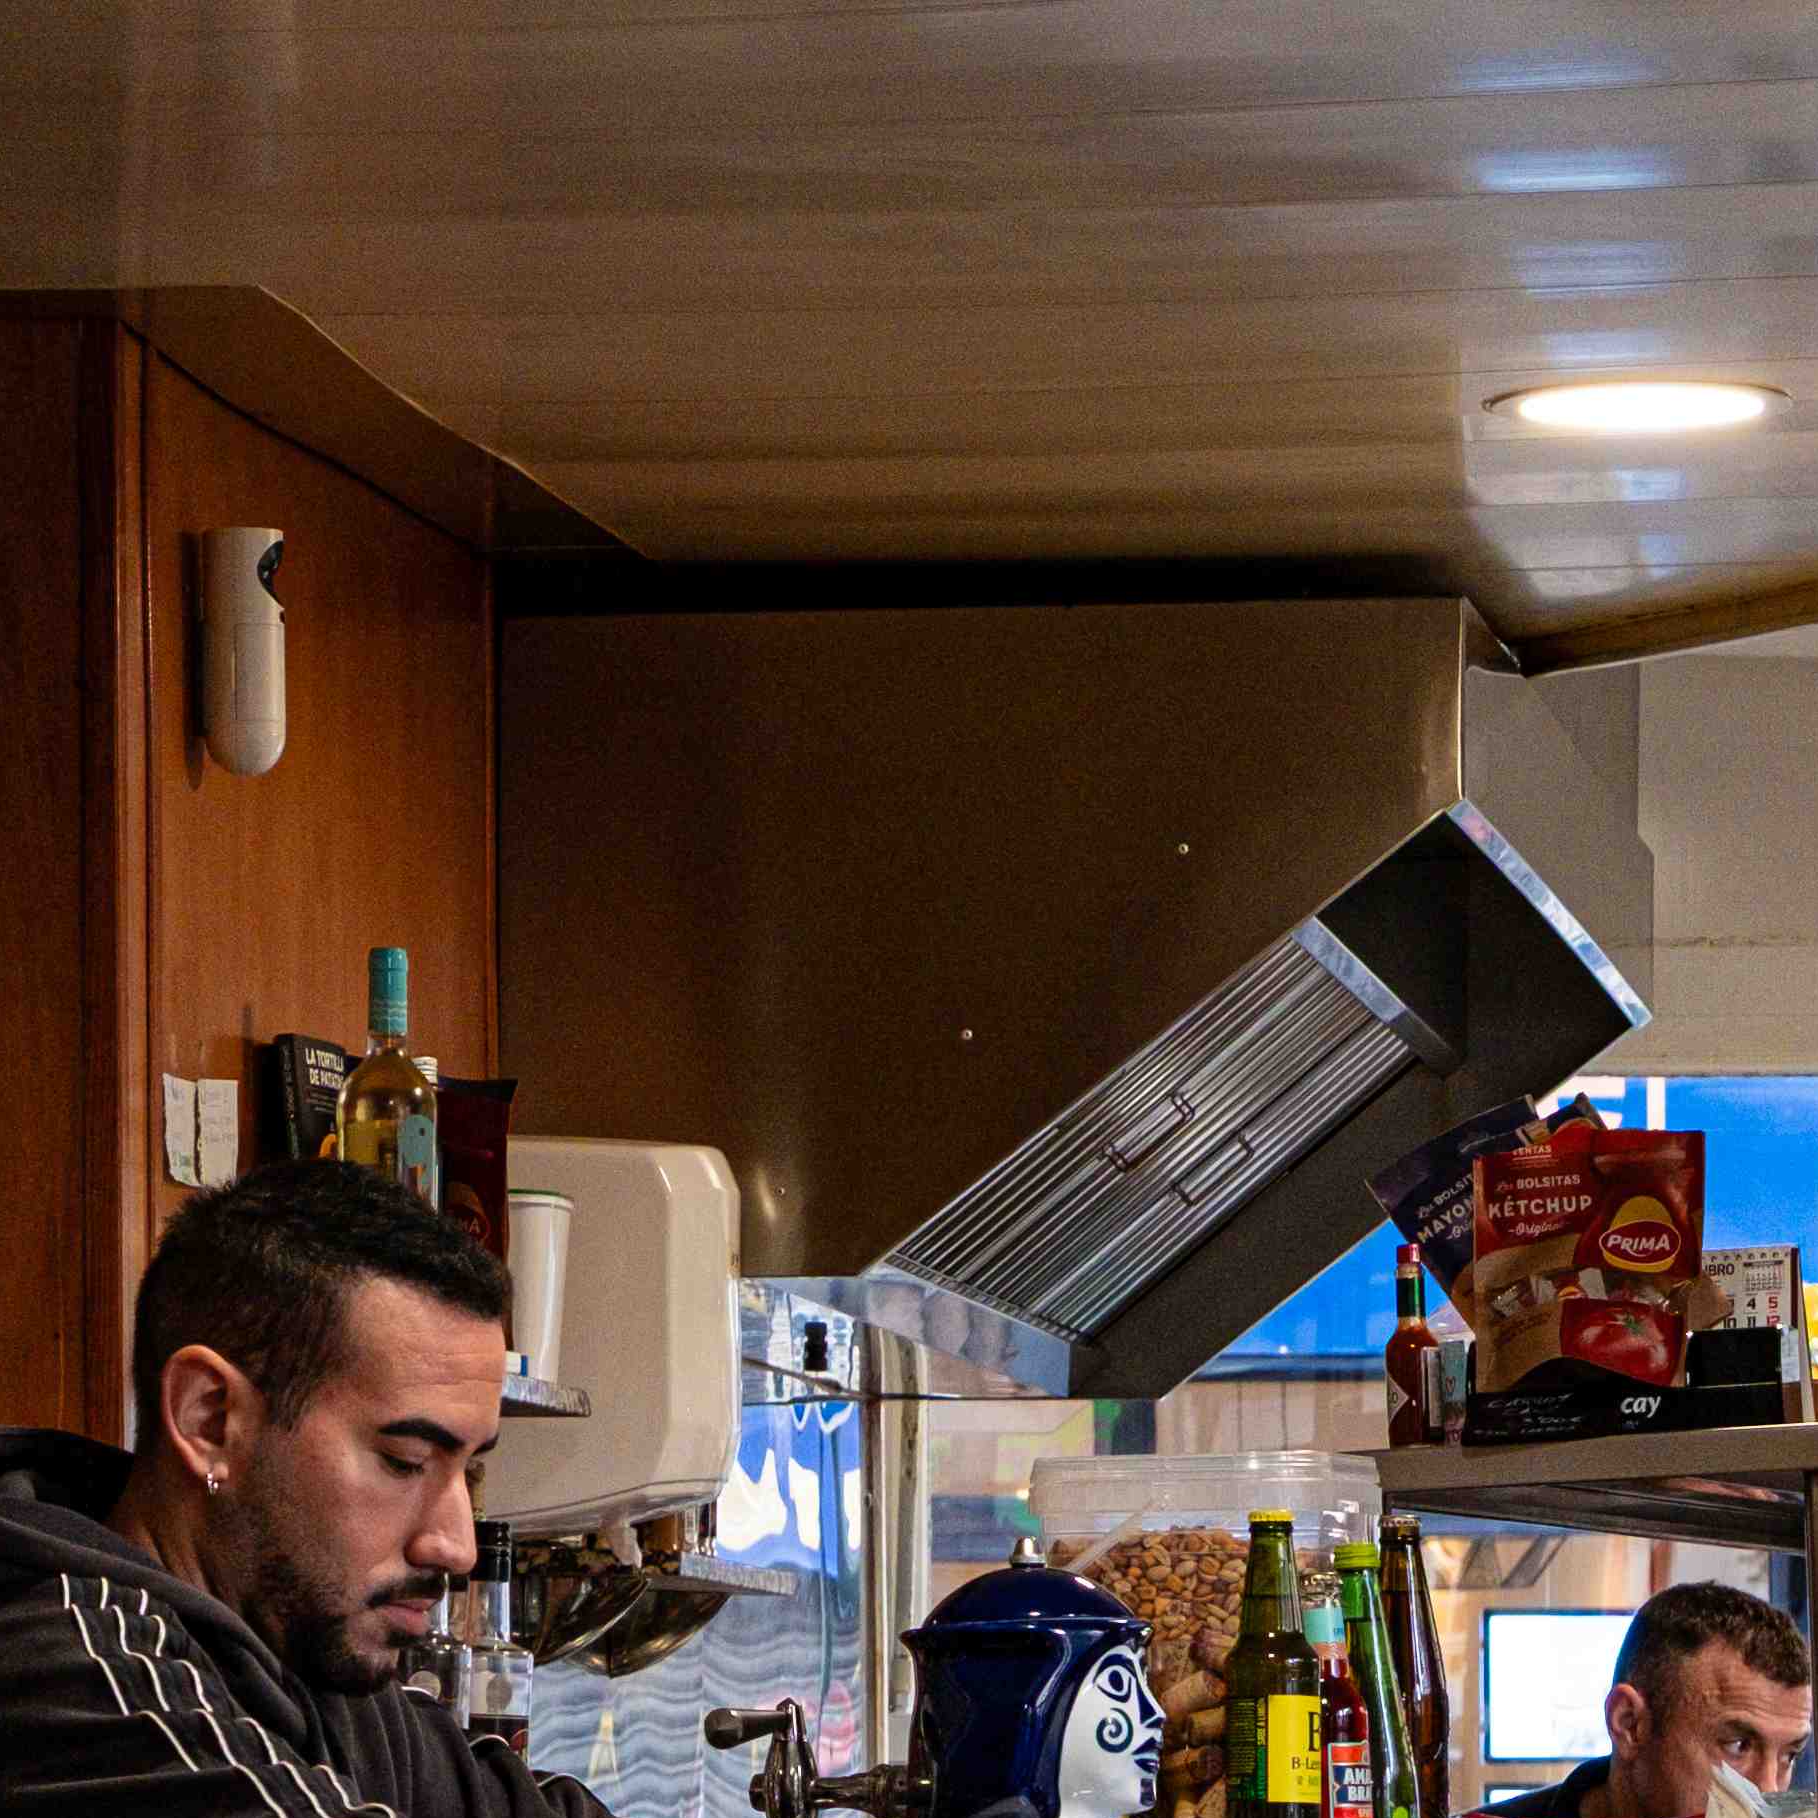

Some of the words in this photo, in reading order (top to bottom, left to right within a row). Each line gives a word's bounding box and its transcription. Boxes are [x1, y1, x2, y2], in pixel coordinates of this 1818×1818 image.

[1516, 1173, 1581, 1190] BOLSITAS
[1488, 1194, 1593, 1219] KÉTCHUP
[1606, 1232, 1671, 1257] PRIMA
[1746, 1297, 1757, 1310] 4
[1768, 1295, 1778, 1310] 5
[1620, 1395, 1661, 1418] cay
